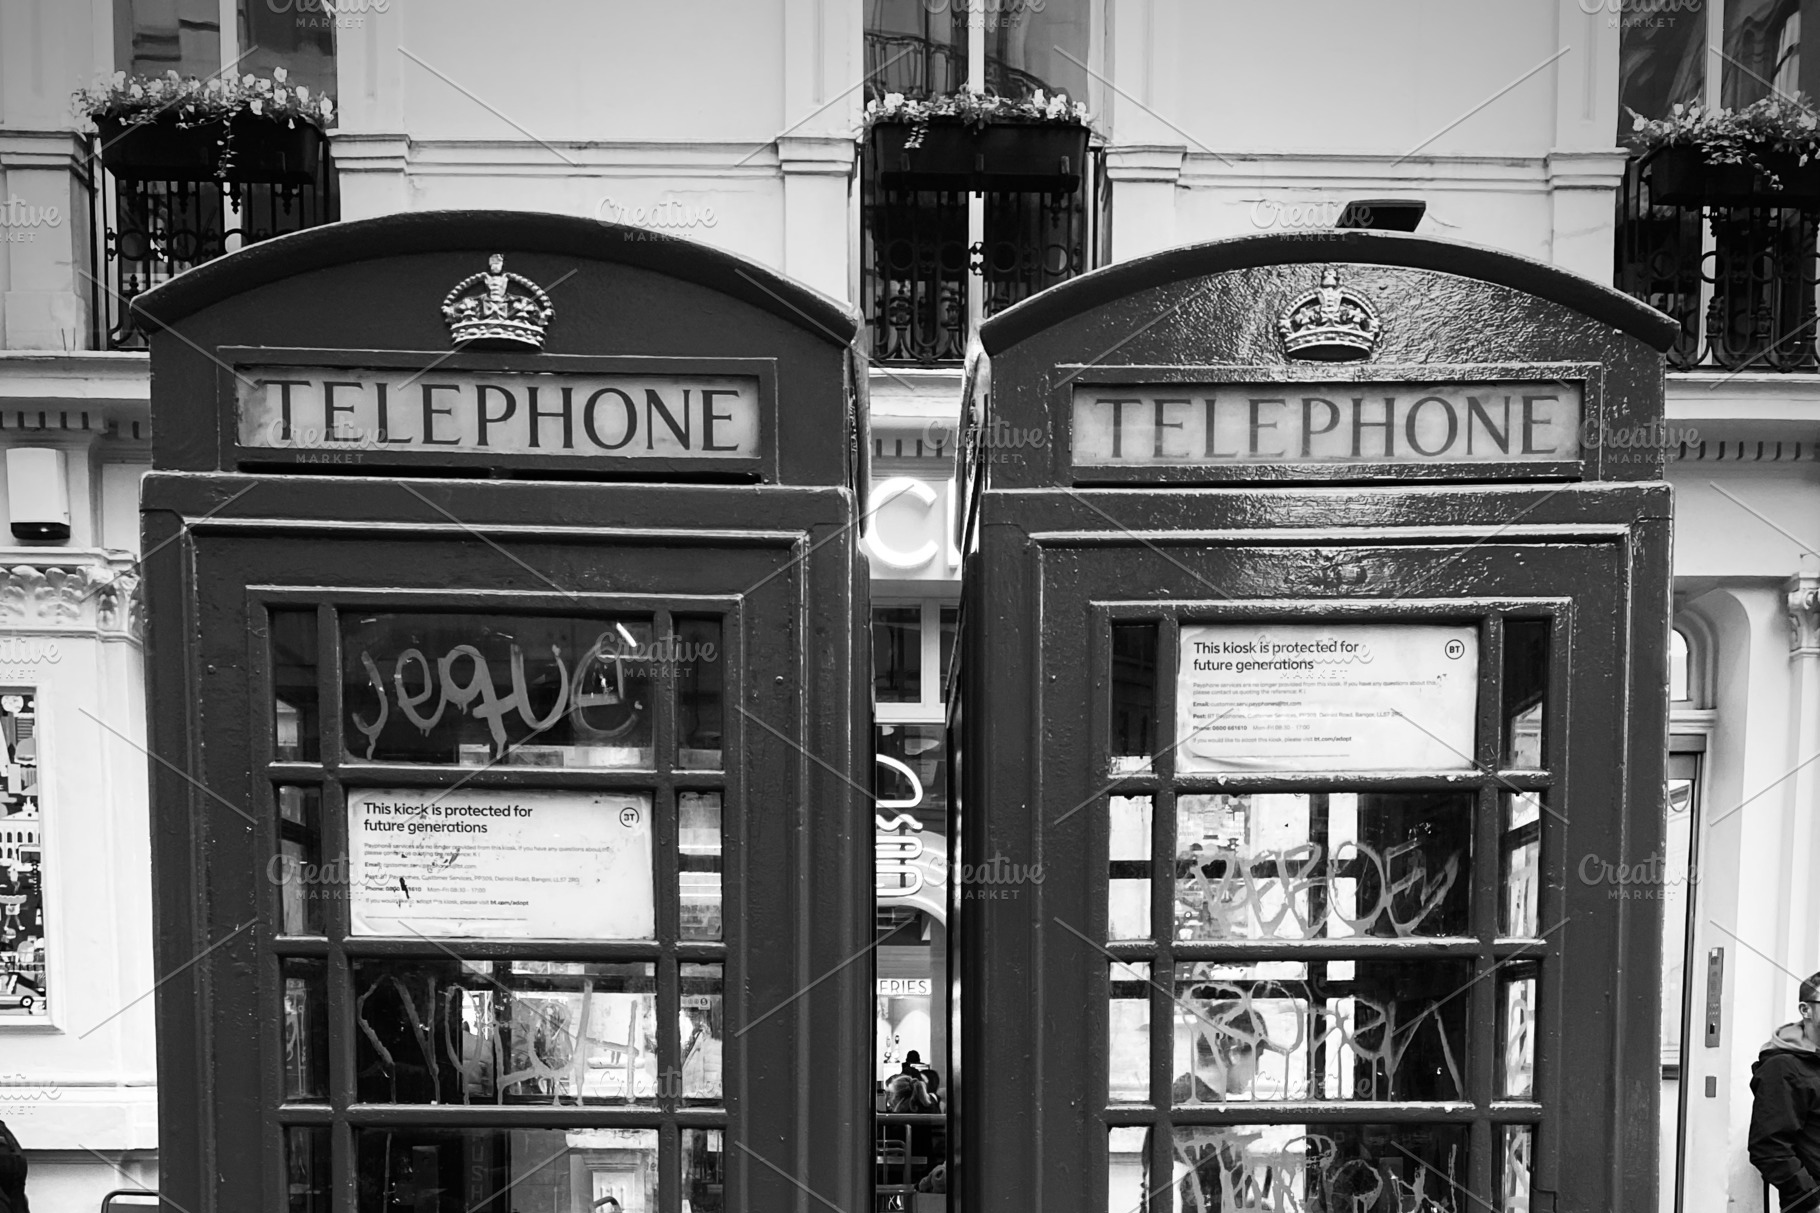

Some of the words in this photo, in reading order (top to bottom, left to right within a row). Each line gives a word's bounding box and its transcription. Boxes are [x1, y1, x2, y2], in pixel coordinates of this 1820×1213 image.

[261, 379, 740, 452] TELEPHONE
[1095, 395, 1560, 459] TELEPHONE
[1194, 642, 1220, 654] This
[1223, 641, 1257, 654] kiosk
[1260, 641, 1269, 653] is
[1272, 640, 1337, 656] protected
[1340, 640, 1359, 653] for
[1194, 658, 1232, 671] future
[1235, 659, 1314, 673] generations
[1260, 681, 1276, 689] longer
[1278, 681, 1302, 689] provided
[1373, 680, 1381, 688] any
[1383, 680, 1408, 688] questions
[364, 802, 391, 815] This
[394, 803, 428, 816] kiosk
[432, 803, 442, 816] is
[445, 804, 511, 819] protected
[513, 804, 533, 817] for
[364, 819, 405, 832] future
[408, 821, 488, 835] generations
[879, 980, 927, 994] FRIES
